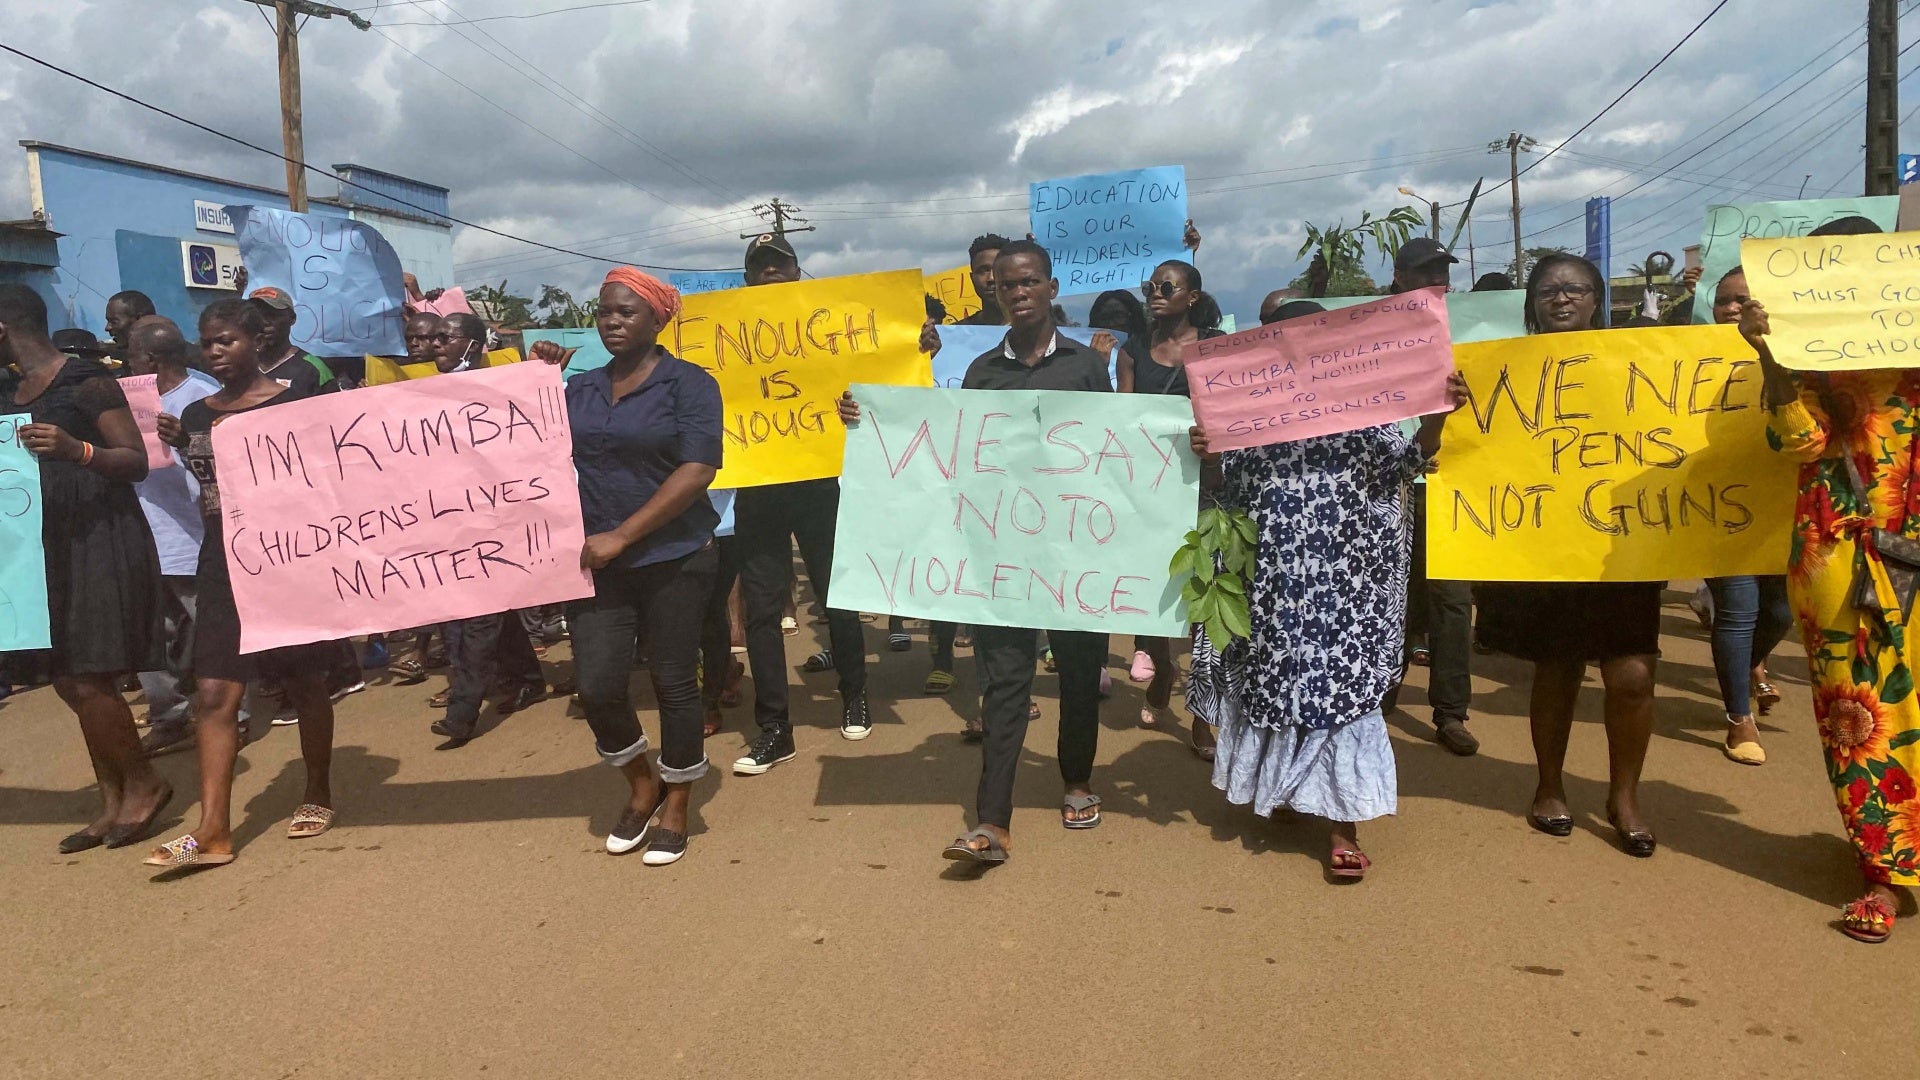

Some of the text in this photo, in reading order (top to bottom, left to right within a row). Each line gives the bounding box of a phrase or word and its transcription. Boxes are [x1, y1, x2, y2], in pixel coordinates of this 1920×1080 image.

[1035, 180, 1180, 213] EDUCATION
[1047, 214, 1134, 239] IS OUR
[1767, 244, 1845, 277] OUR
[696, 279, 716, 290] ARE
[1793, 284, 1920, 302] MUST GO
[1199, 299, 1429, 356] ENOUGH IS ENOUGH
[1871, 309, 1914, 330] TO
[760, 370, 802, 400] IS
[1205, 335, 1435, 394] KUMBA POPULATION
[1226, 390, 1406, 436] SECESSIONISTS
[1459, 353, 1772, 434] WE NEE
[244, 386, 564, 488] I'M KUMBA!!!
[868, 408, 1181, 492] WE SAY
[1532, 427, 1688, 475] PENS
[429, 476, 550, 519] LIVES
[953, 486, 1117, 545] NO TO
[1452, 479, 1755, 541] NOT GUNS
[866, 550, 1151, 618] VIOLENCE
